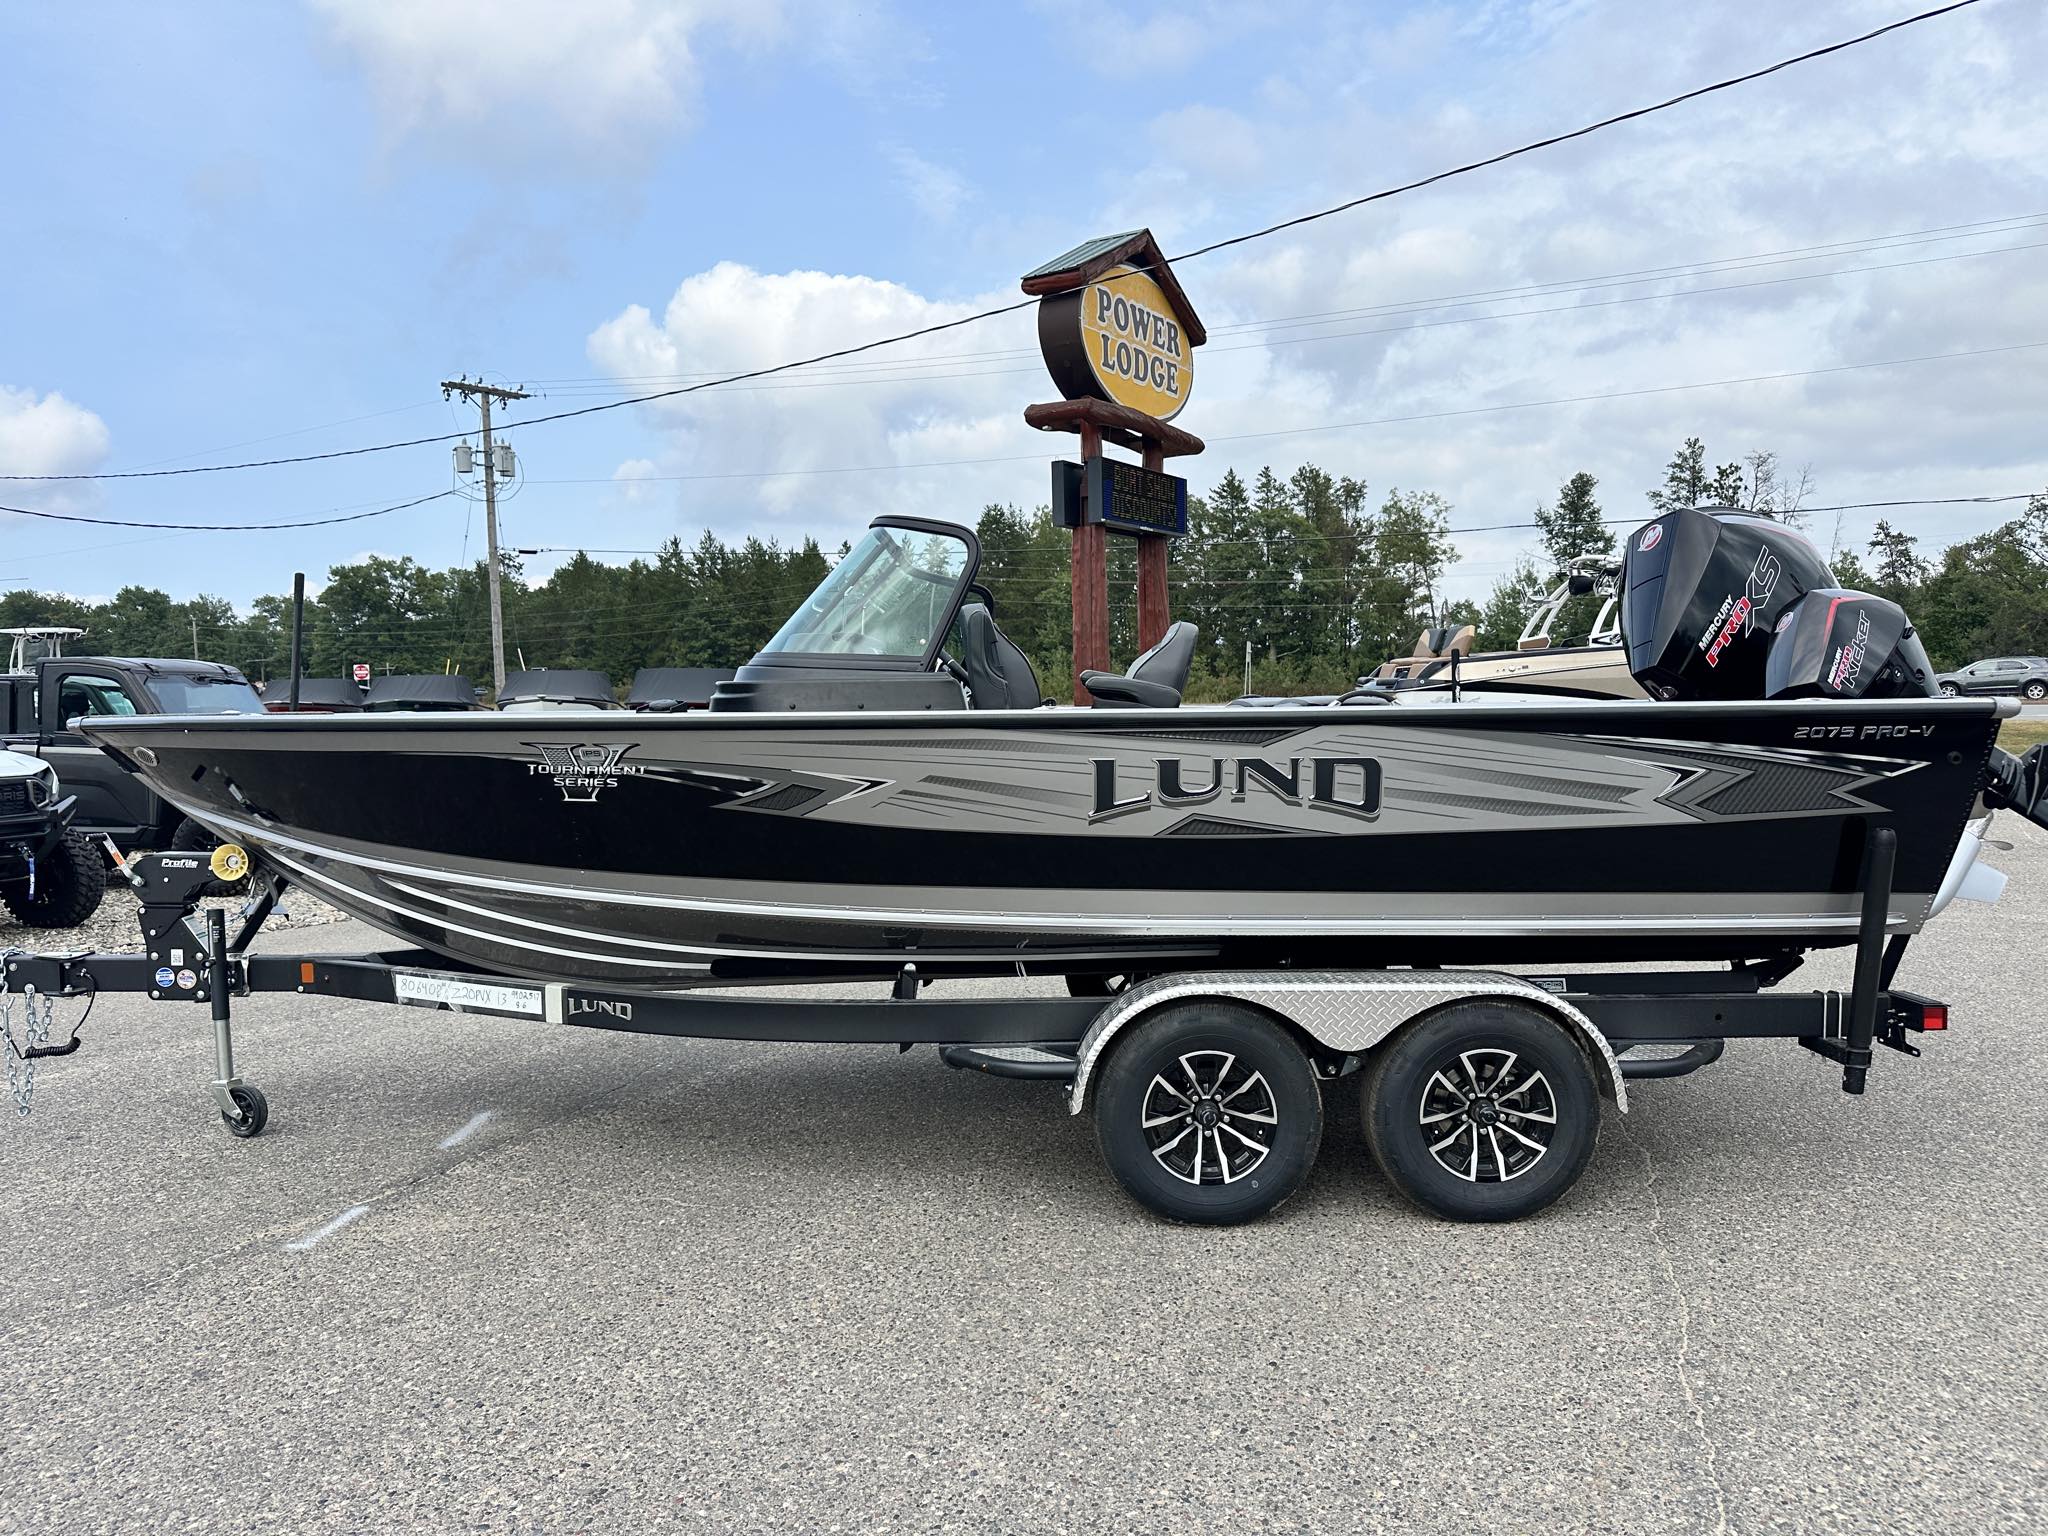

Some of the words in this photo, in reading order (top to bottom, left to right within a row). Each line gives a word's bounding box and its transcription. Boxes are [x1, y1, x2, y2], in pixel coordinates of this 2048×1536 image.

[1097, 287, 1181, 358] POWER
[1101, 333, 1179, 395] LODGE
[1114, 464, 1143, 494] BOAT
[1698, 594, 1734, 651] MERCURY
[1705, 596, 1751, 668] PRO
[1745, 545, 1780, 638] XS
[1827, 646, 1843, 685] MERCURY
[1833, 645, 1853, 691] PRO
[1794, 726, 1856, 739] 2075
[1860, 725, 1936, 740] PRO-V
[527, 763, 647, 776] TOURNAMENT
[553, 777, 618, 788] SERIES
[1088, 757, 1383, 819] LUND
[161, 858, 199, 869] Profile
[568, 997, 633, 1021] LUND
